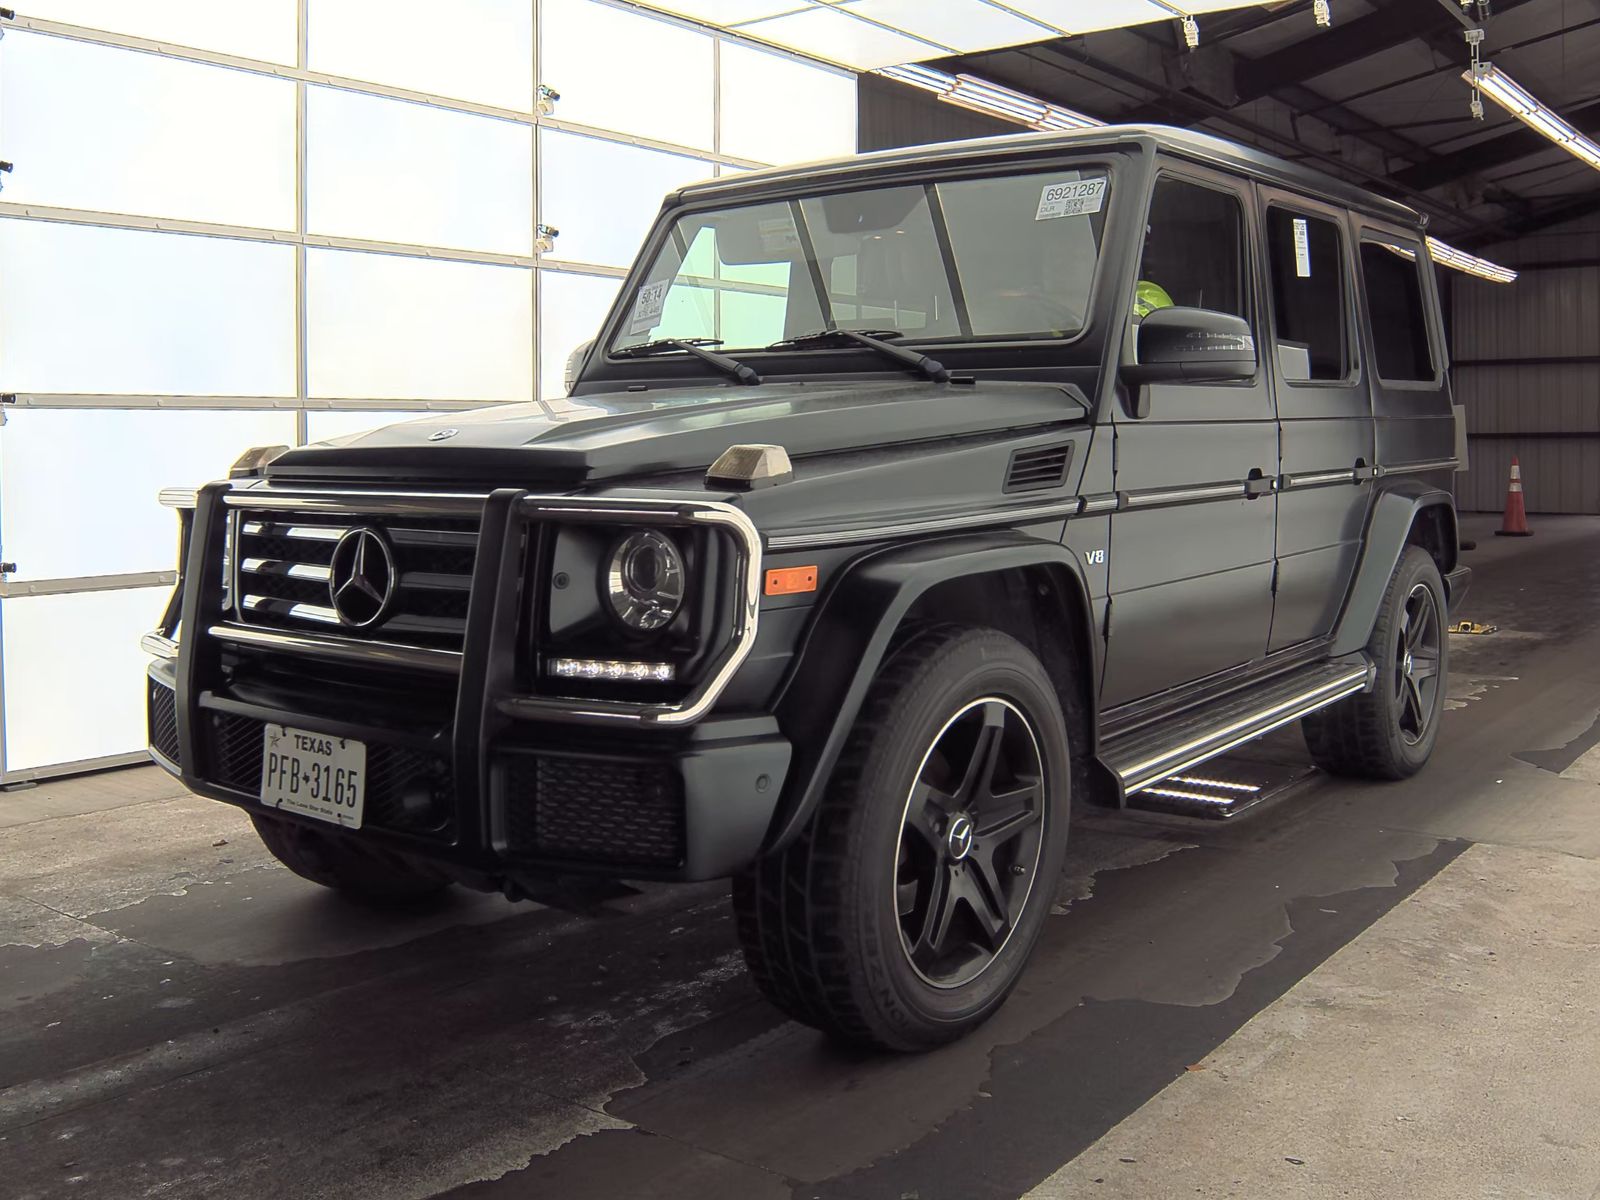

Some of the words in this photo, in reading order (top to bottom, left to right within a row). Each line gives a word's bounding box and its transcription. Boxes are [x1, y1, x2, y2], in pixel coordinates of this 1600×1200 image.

[1046, 182, 1105, 202] 6921287
[1040, 205, 1056, 213] DLR
[1084, 549, 1104, 565] V8
[294, 734, 332, 756] TEXAS
